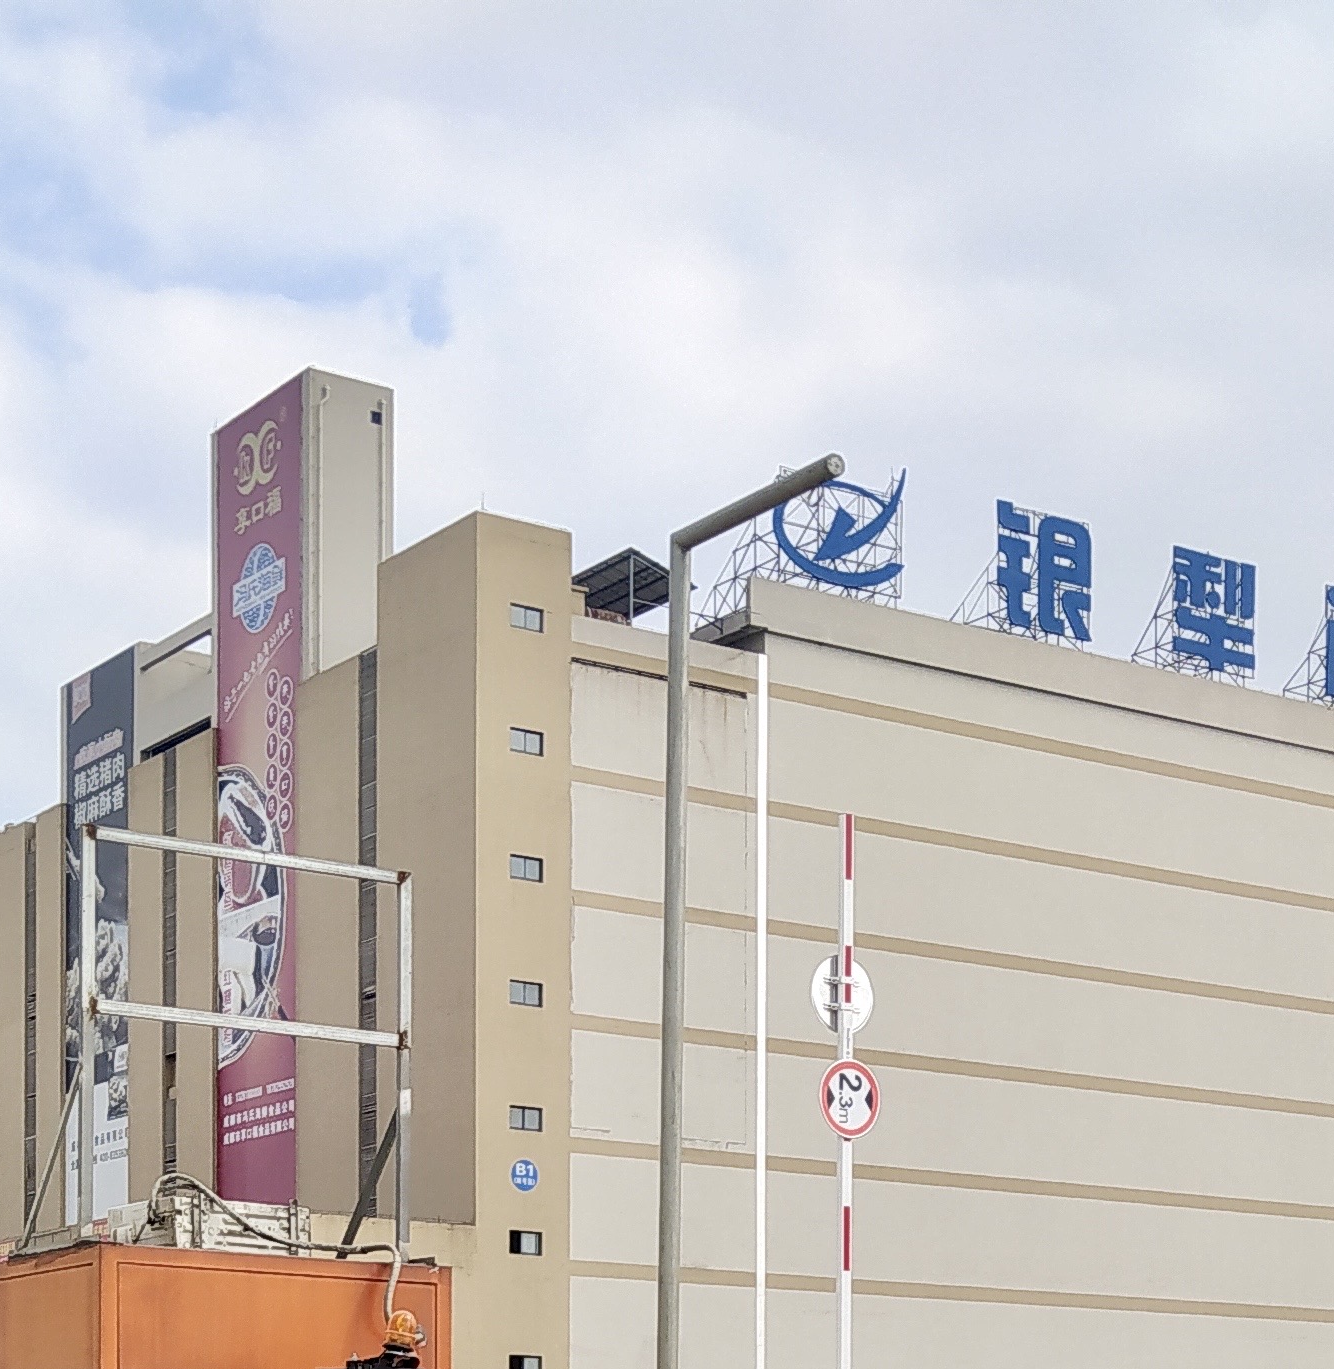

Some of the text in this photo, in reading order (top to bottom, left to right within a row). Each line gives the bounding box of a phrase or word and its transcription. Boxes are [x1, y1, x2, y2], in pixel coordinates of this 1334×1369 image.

[74, 752, 125, 801] 精选猪肉
[839, 1073, 863, 1123] 2.3m
[515, 1162, 534, 1177] B1
